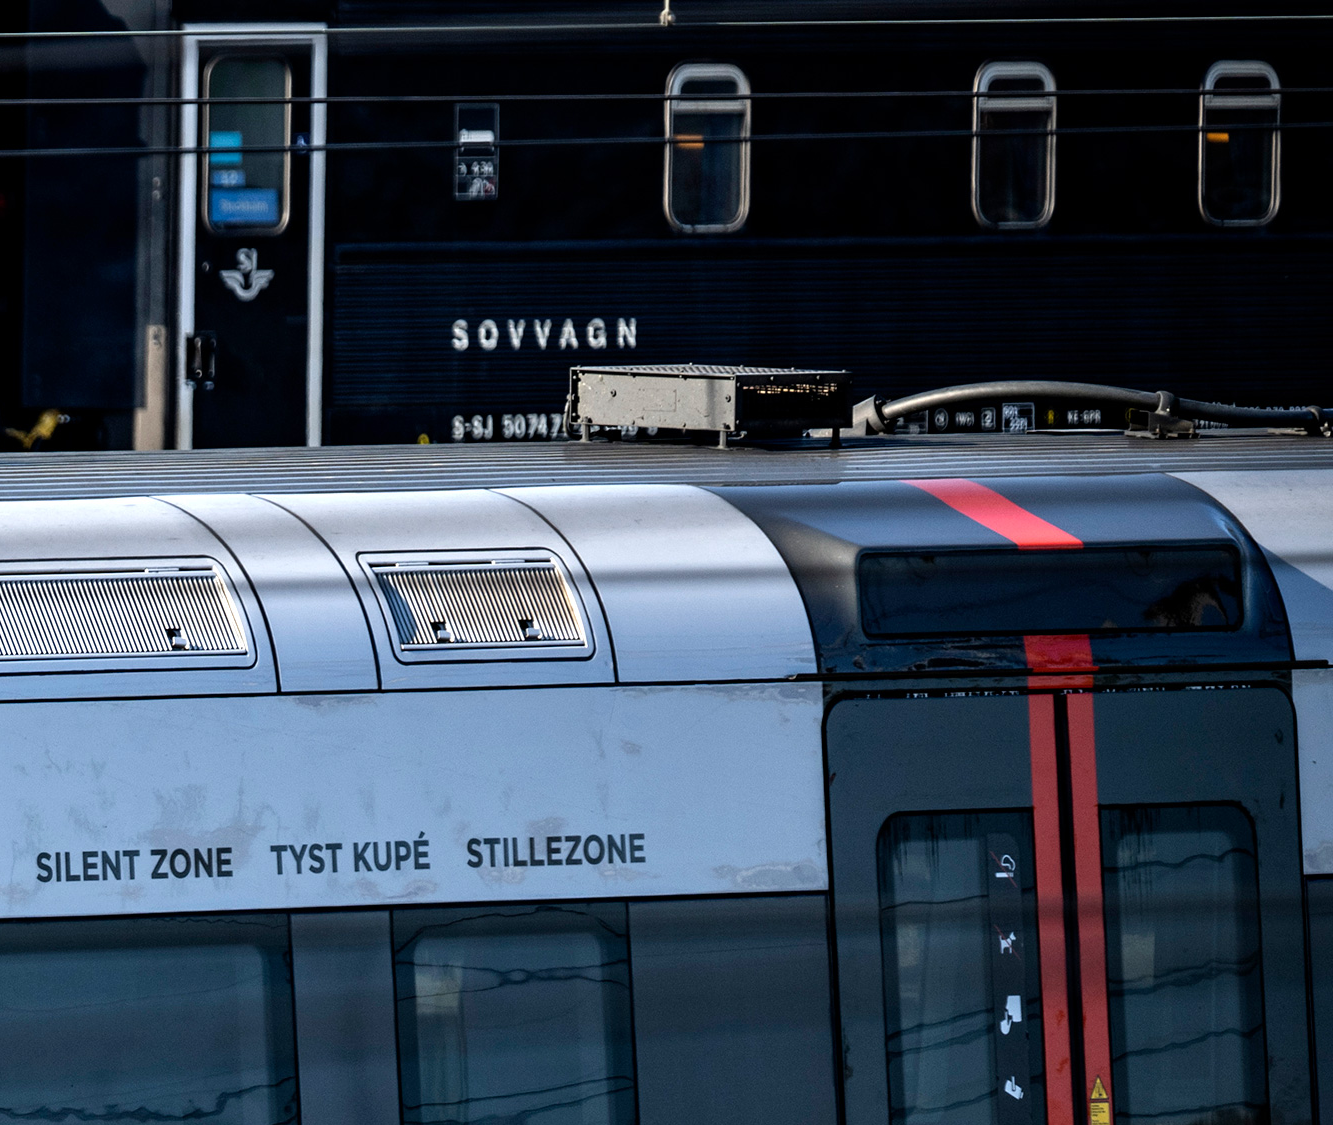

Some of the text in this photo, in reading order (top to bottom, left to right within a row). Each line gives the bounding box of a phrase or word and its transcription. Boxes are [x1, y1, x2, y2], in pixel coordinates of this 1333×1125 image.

[451, 317, 637, 351] SOVVAGN
[37, 850, 140, 882] SILENT
[151, 847, 232, 879] ZONE
[270, 843, 342, 875] TYST
[354, 831, 430, 872] KUPÉ
[467, 834, 645, 868] STILLEZONE
